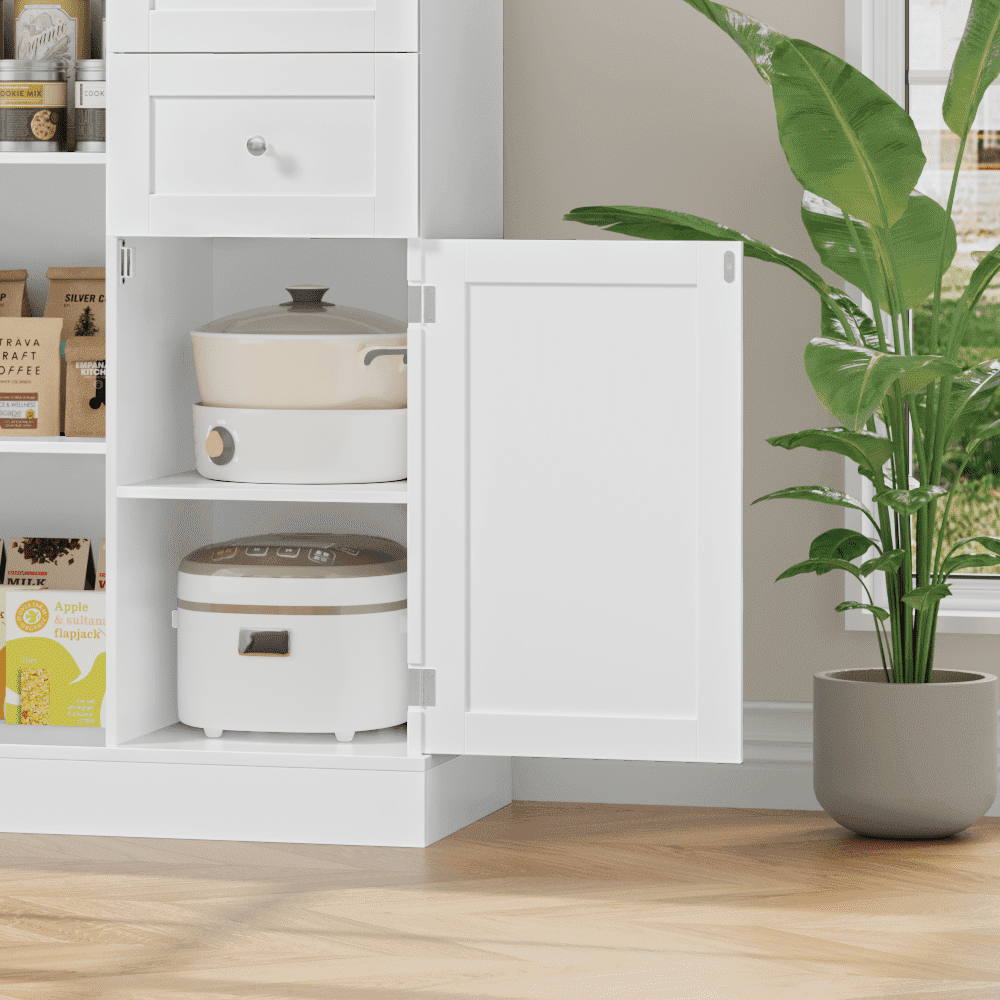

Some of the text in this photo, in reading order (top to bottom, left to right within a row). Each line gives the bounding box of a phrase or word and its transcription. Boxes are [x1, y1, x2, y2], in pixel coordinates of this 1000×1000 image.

[64, 293, 96, 303] SILVER
[75, 361, 106, 369] EMPAN
[7, 578, 47, 586] MILK
[54, 601, 89, 614] Apple
[54, 614, 63, 625] &
[54, 628, 101, 641] flapjack
